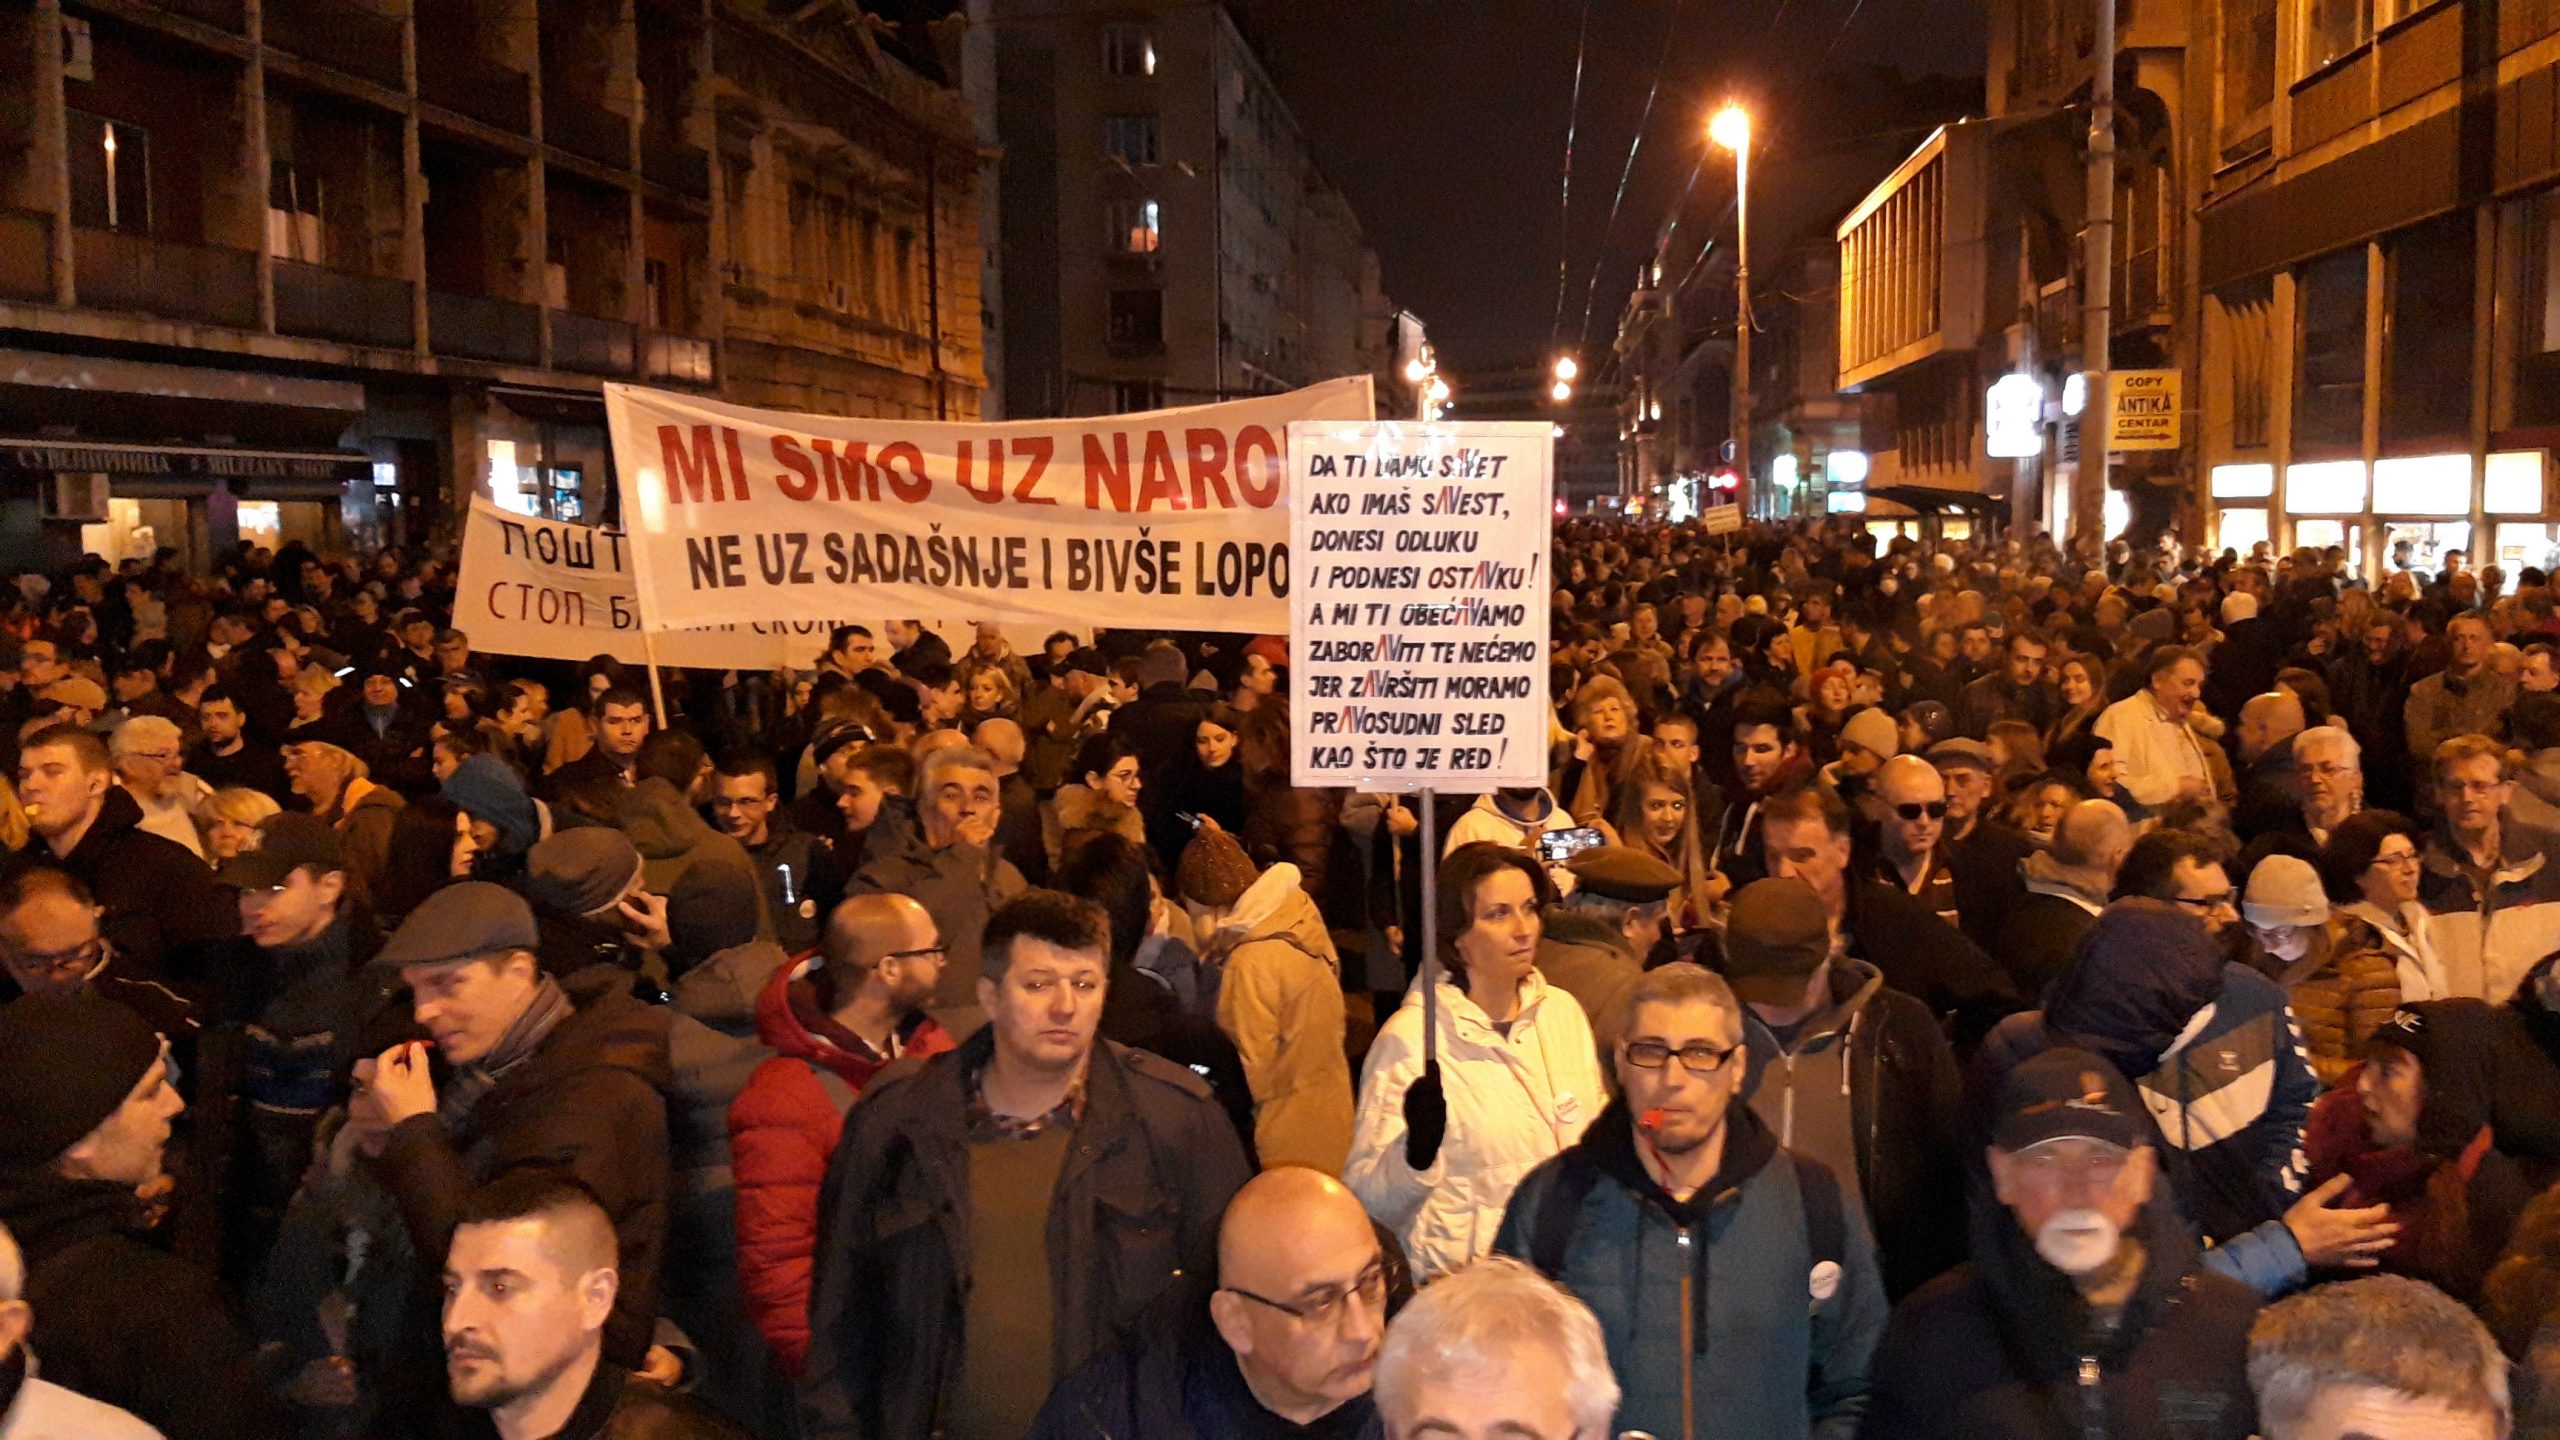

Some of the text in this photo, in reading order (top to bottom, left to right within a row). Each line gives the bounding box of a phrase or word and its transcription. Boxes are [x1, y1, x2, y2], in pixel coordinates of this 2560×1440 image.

[2125, 376, 2163, 388] COPY
[2117, 393, 2171, 414] ANTIKA
[2118, 418, 2169, 429] CENTAR
[657, 424, 1289, 512] MI SMO UZ NARO
[1309, 454, 1337, 478] DA
[1344, 455, 1367, 478] TI
[1309, 493, 1350, 515] AKO
[1361, 486, 1411, 516] IMAŠ
[1310, 530, 1479, 552] DONESI ODLUKU
[686, 534, 747, 591] NE
[755, 532, 815, 586] UZ
[824, 523, 1029, 589] SADAŠNJE
[1042, 537, 1052, 590] I
[1067, 526, 1181, 595] BIVŠE
[1309, 565, 1320, 588] I
[1328, 565, 1421, 589] PODNESI
[488, 582, 585, 627] СТОП
[1309, 603, 1324, 626] A
[1331, 603, 1358, 626] MI
[1364, 603, 1391, 626] TI
[1430, 642, 1456, 663] TE
[1459, 634, 1537, 663] NEĆEMO
[1308, 669, 1531, 699] JER ZAVRŠITI MORAMO
[1310, 705, 1505, 736] PRAVOSUDNI SLED
[1309, 746, 1354, 769] KAO
[1363, 740, 1407, 769] ŠTO
[1415, 747, 1441, 769] JE
